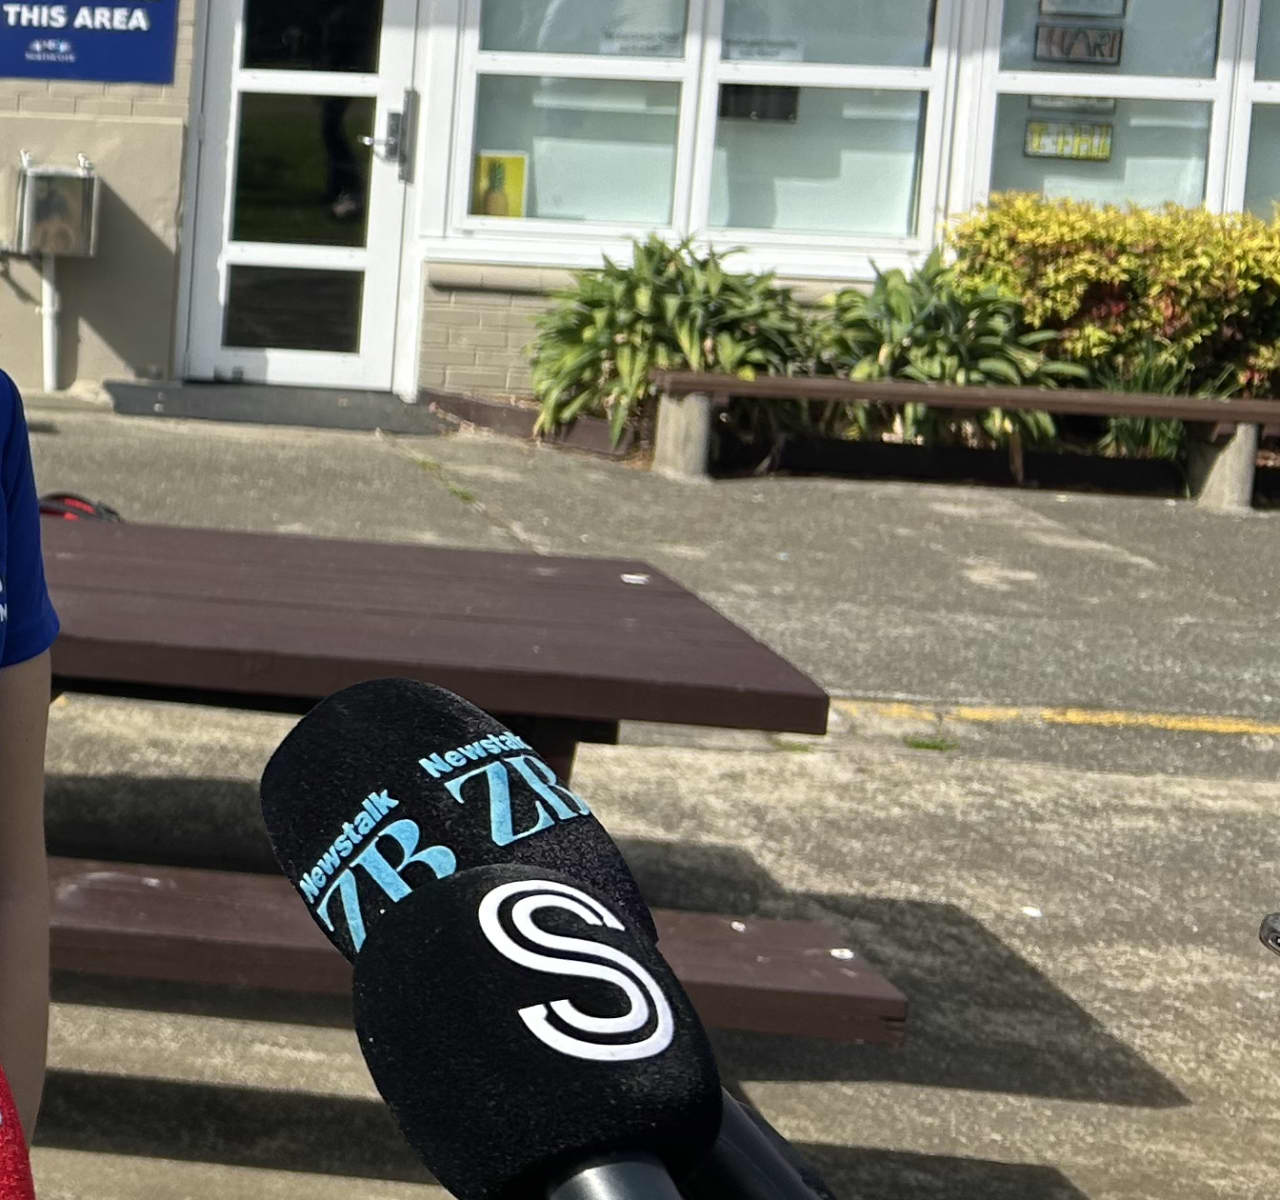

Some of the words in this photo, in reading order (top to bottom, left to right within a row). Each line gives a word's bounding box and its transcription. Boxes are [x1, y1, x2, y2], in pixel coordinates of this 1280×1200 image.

[3, 4, 67, 28] THIS
[73, 6, 151, 32] AREA
[299, 789, 400, 904] Newstalk
[478, 879, 675, 1062] S
